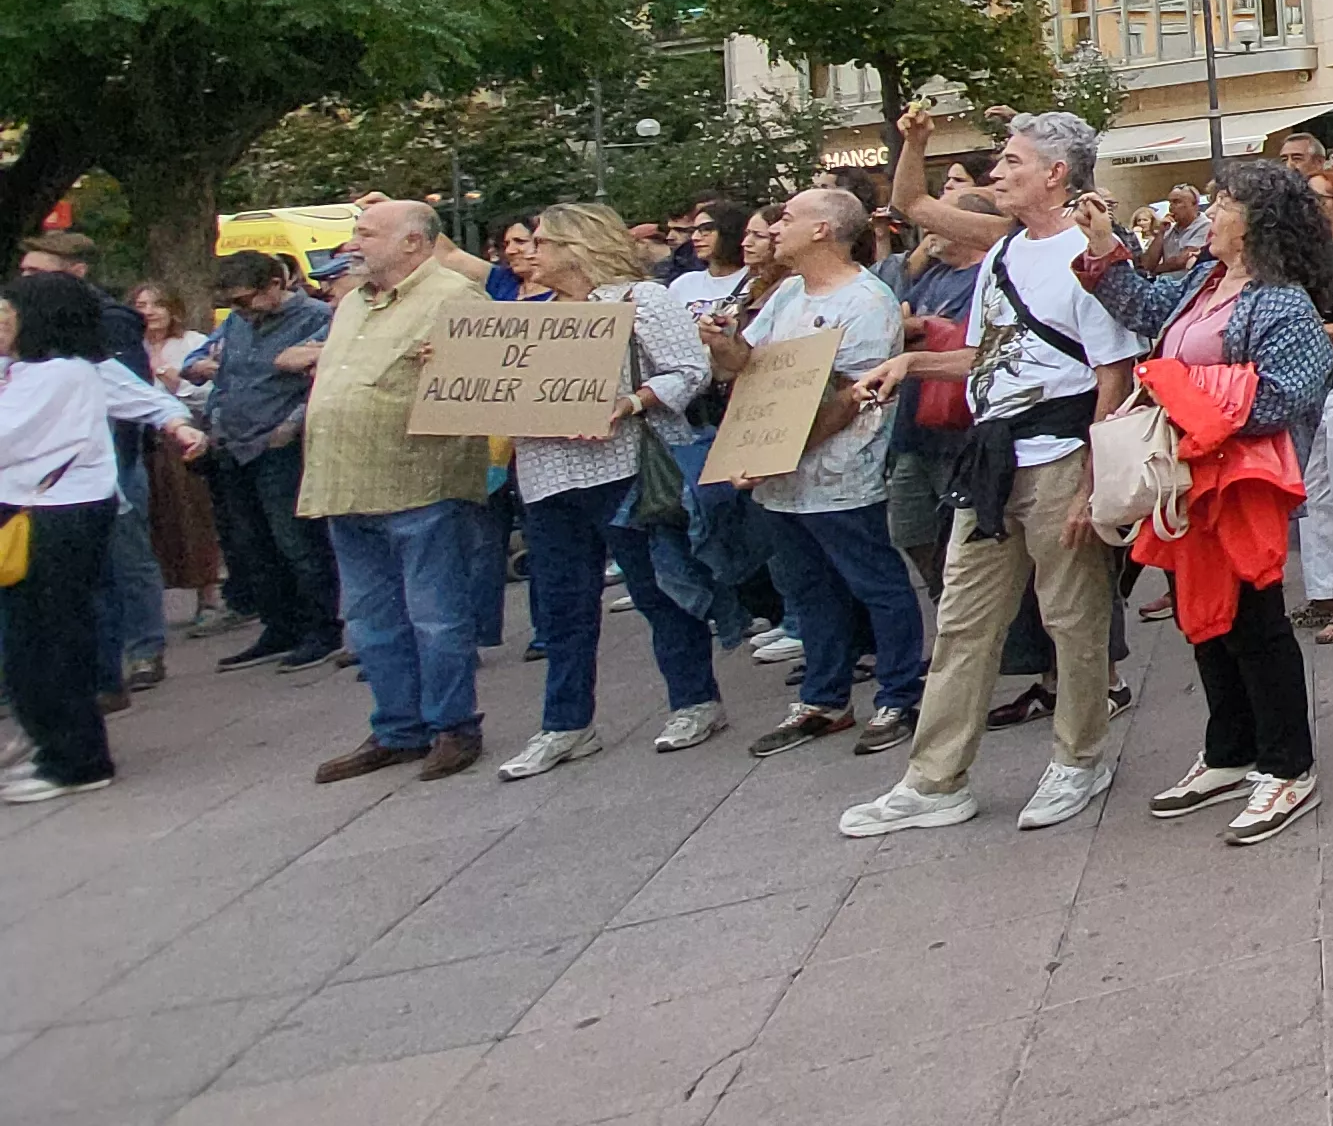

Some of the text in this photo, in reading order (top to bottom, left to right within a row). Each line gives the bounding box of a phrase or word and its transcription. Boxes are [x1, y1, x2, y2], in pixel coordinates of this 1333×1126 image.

[824, 147, 889, 170] MANGO
[449, 316, 617, 340] VIVIENDA PUBLICA
[502, 344, 538, 368] DE
[423, 377, 609, 403] ALQUILER SOCIAL
